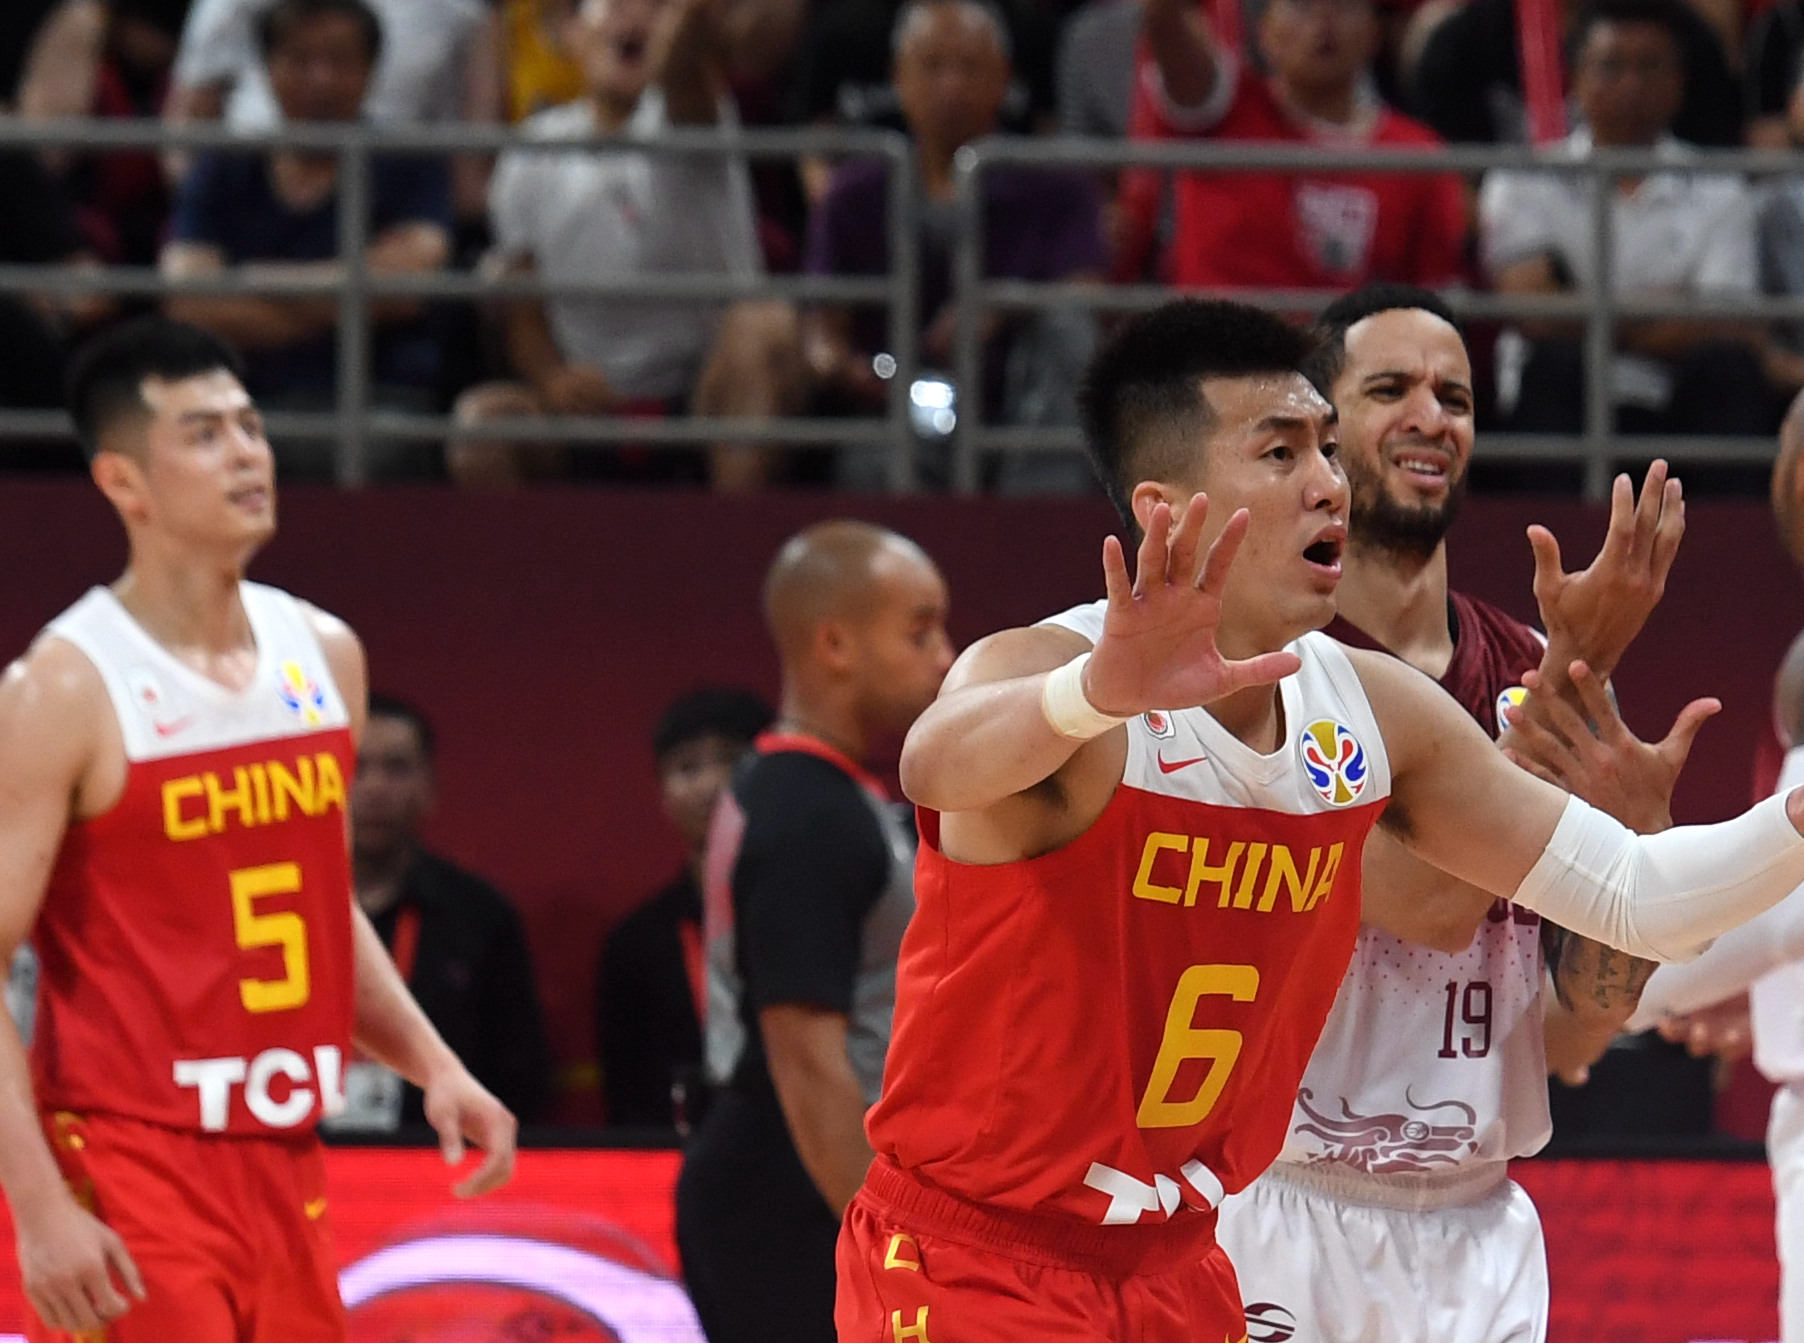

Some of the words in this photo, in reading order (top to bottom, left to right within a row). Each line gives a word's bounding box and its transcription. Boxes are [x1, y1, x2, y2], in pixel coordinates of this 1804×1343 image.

[161, 752, 345, 841] CHINA
[1132, 832, 1344, 912] CHINA
[228, 861, 310, 1013] 5
[1136, 964, 1260, 1128] 6
[1437, 981, 1493, 1058] 19
